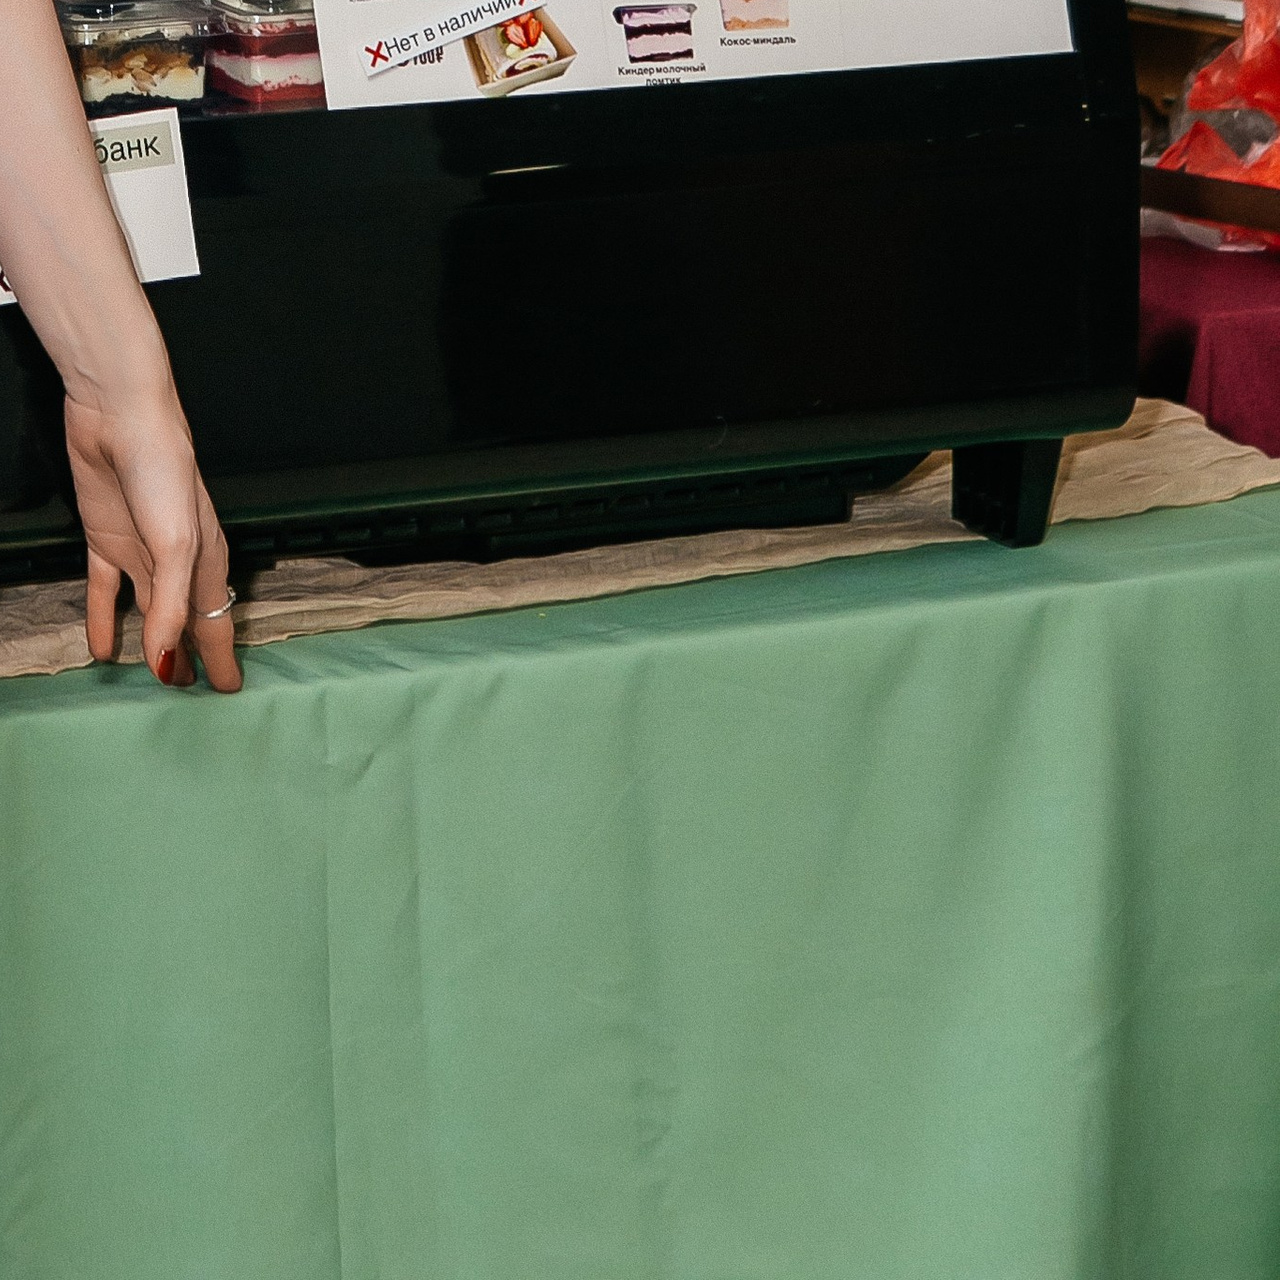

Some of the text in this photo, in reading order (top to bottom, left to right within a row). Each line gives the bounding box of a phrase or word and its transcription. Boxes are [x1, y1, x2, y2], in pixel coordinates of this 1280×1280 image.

[384, 33, 420, 58] Нет
[424, 27, 436, 42] в
[618, 63, 706, 76] Киндер молочный
